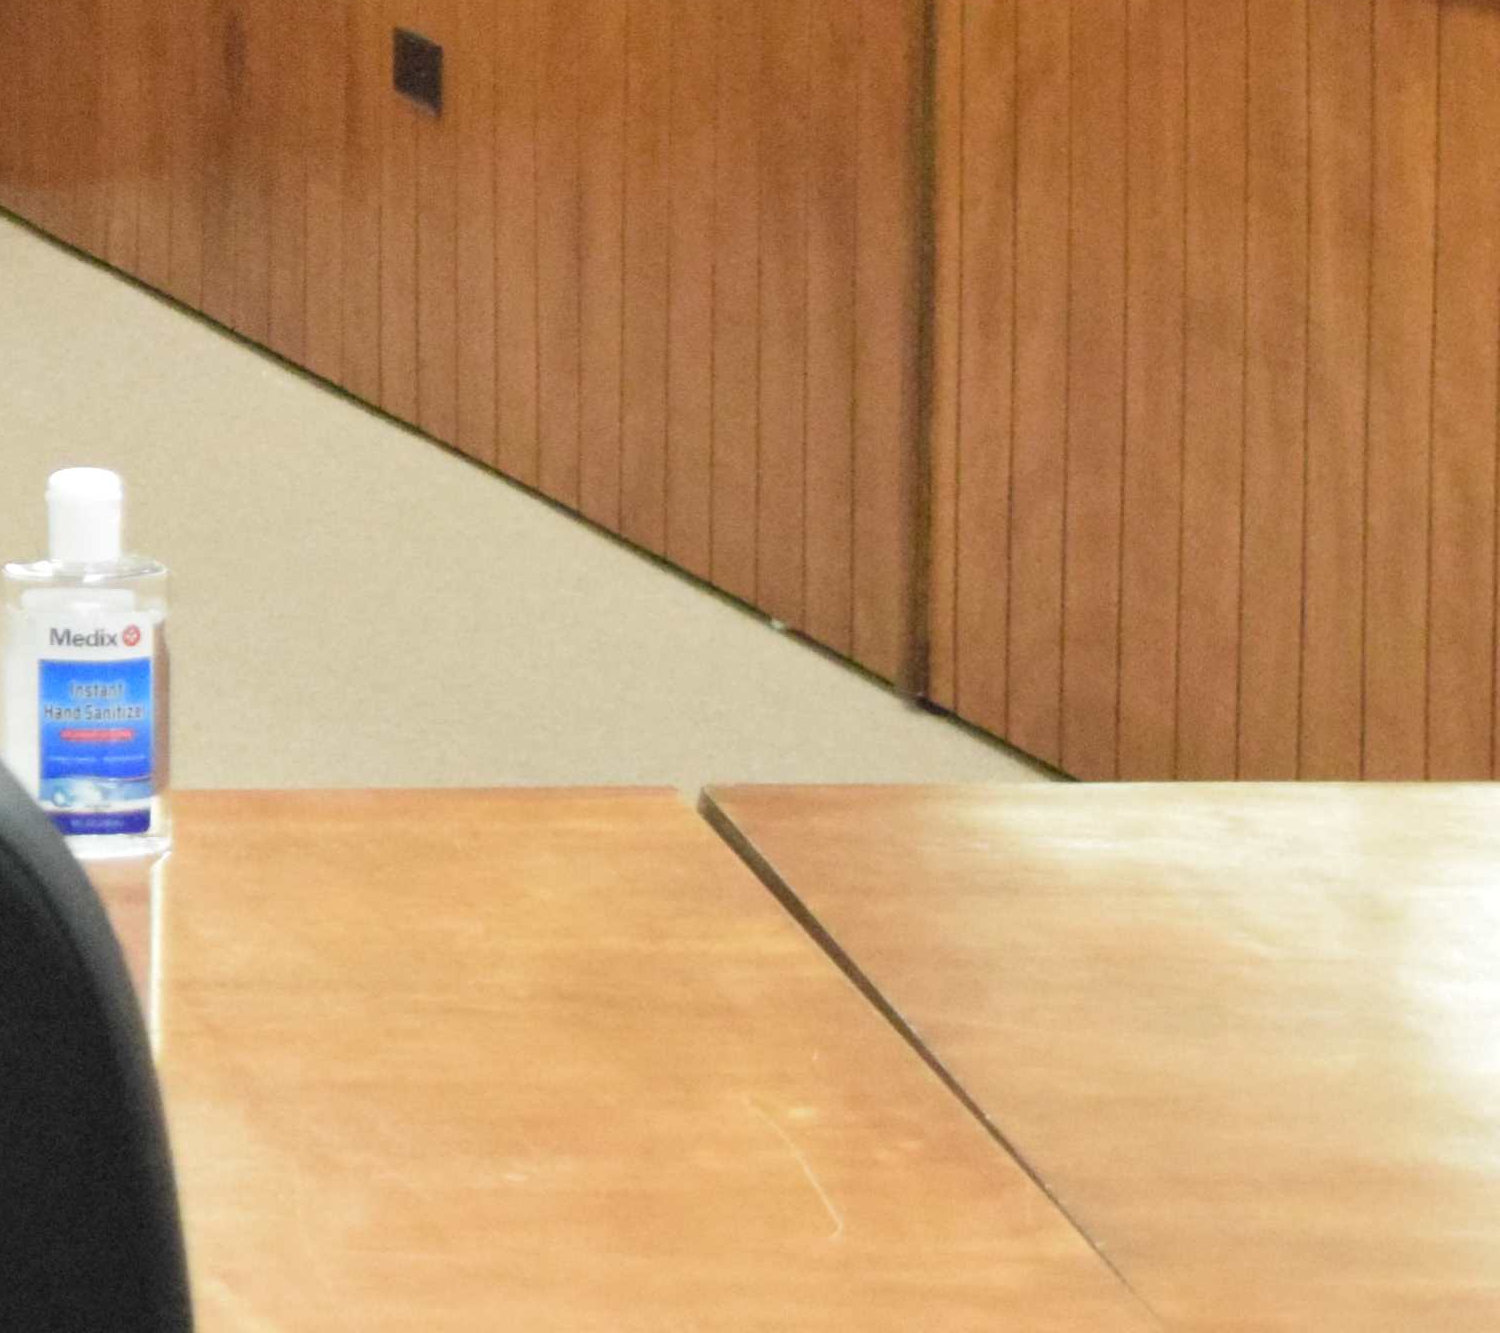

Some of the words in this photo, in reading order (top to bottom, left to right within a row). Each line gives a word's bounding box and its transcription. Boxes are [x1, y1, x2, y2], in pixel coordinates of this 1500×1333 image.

[49, 627, 118, 647] Medix
[69, 683, 123, 699] Instant
[43, 704, 81, 721] Hand
